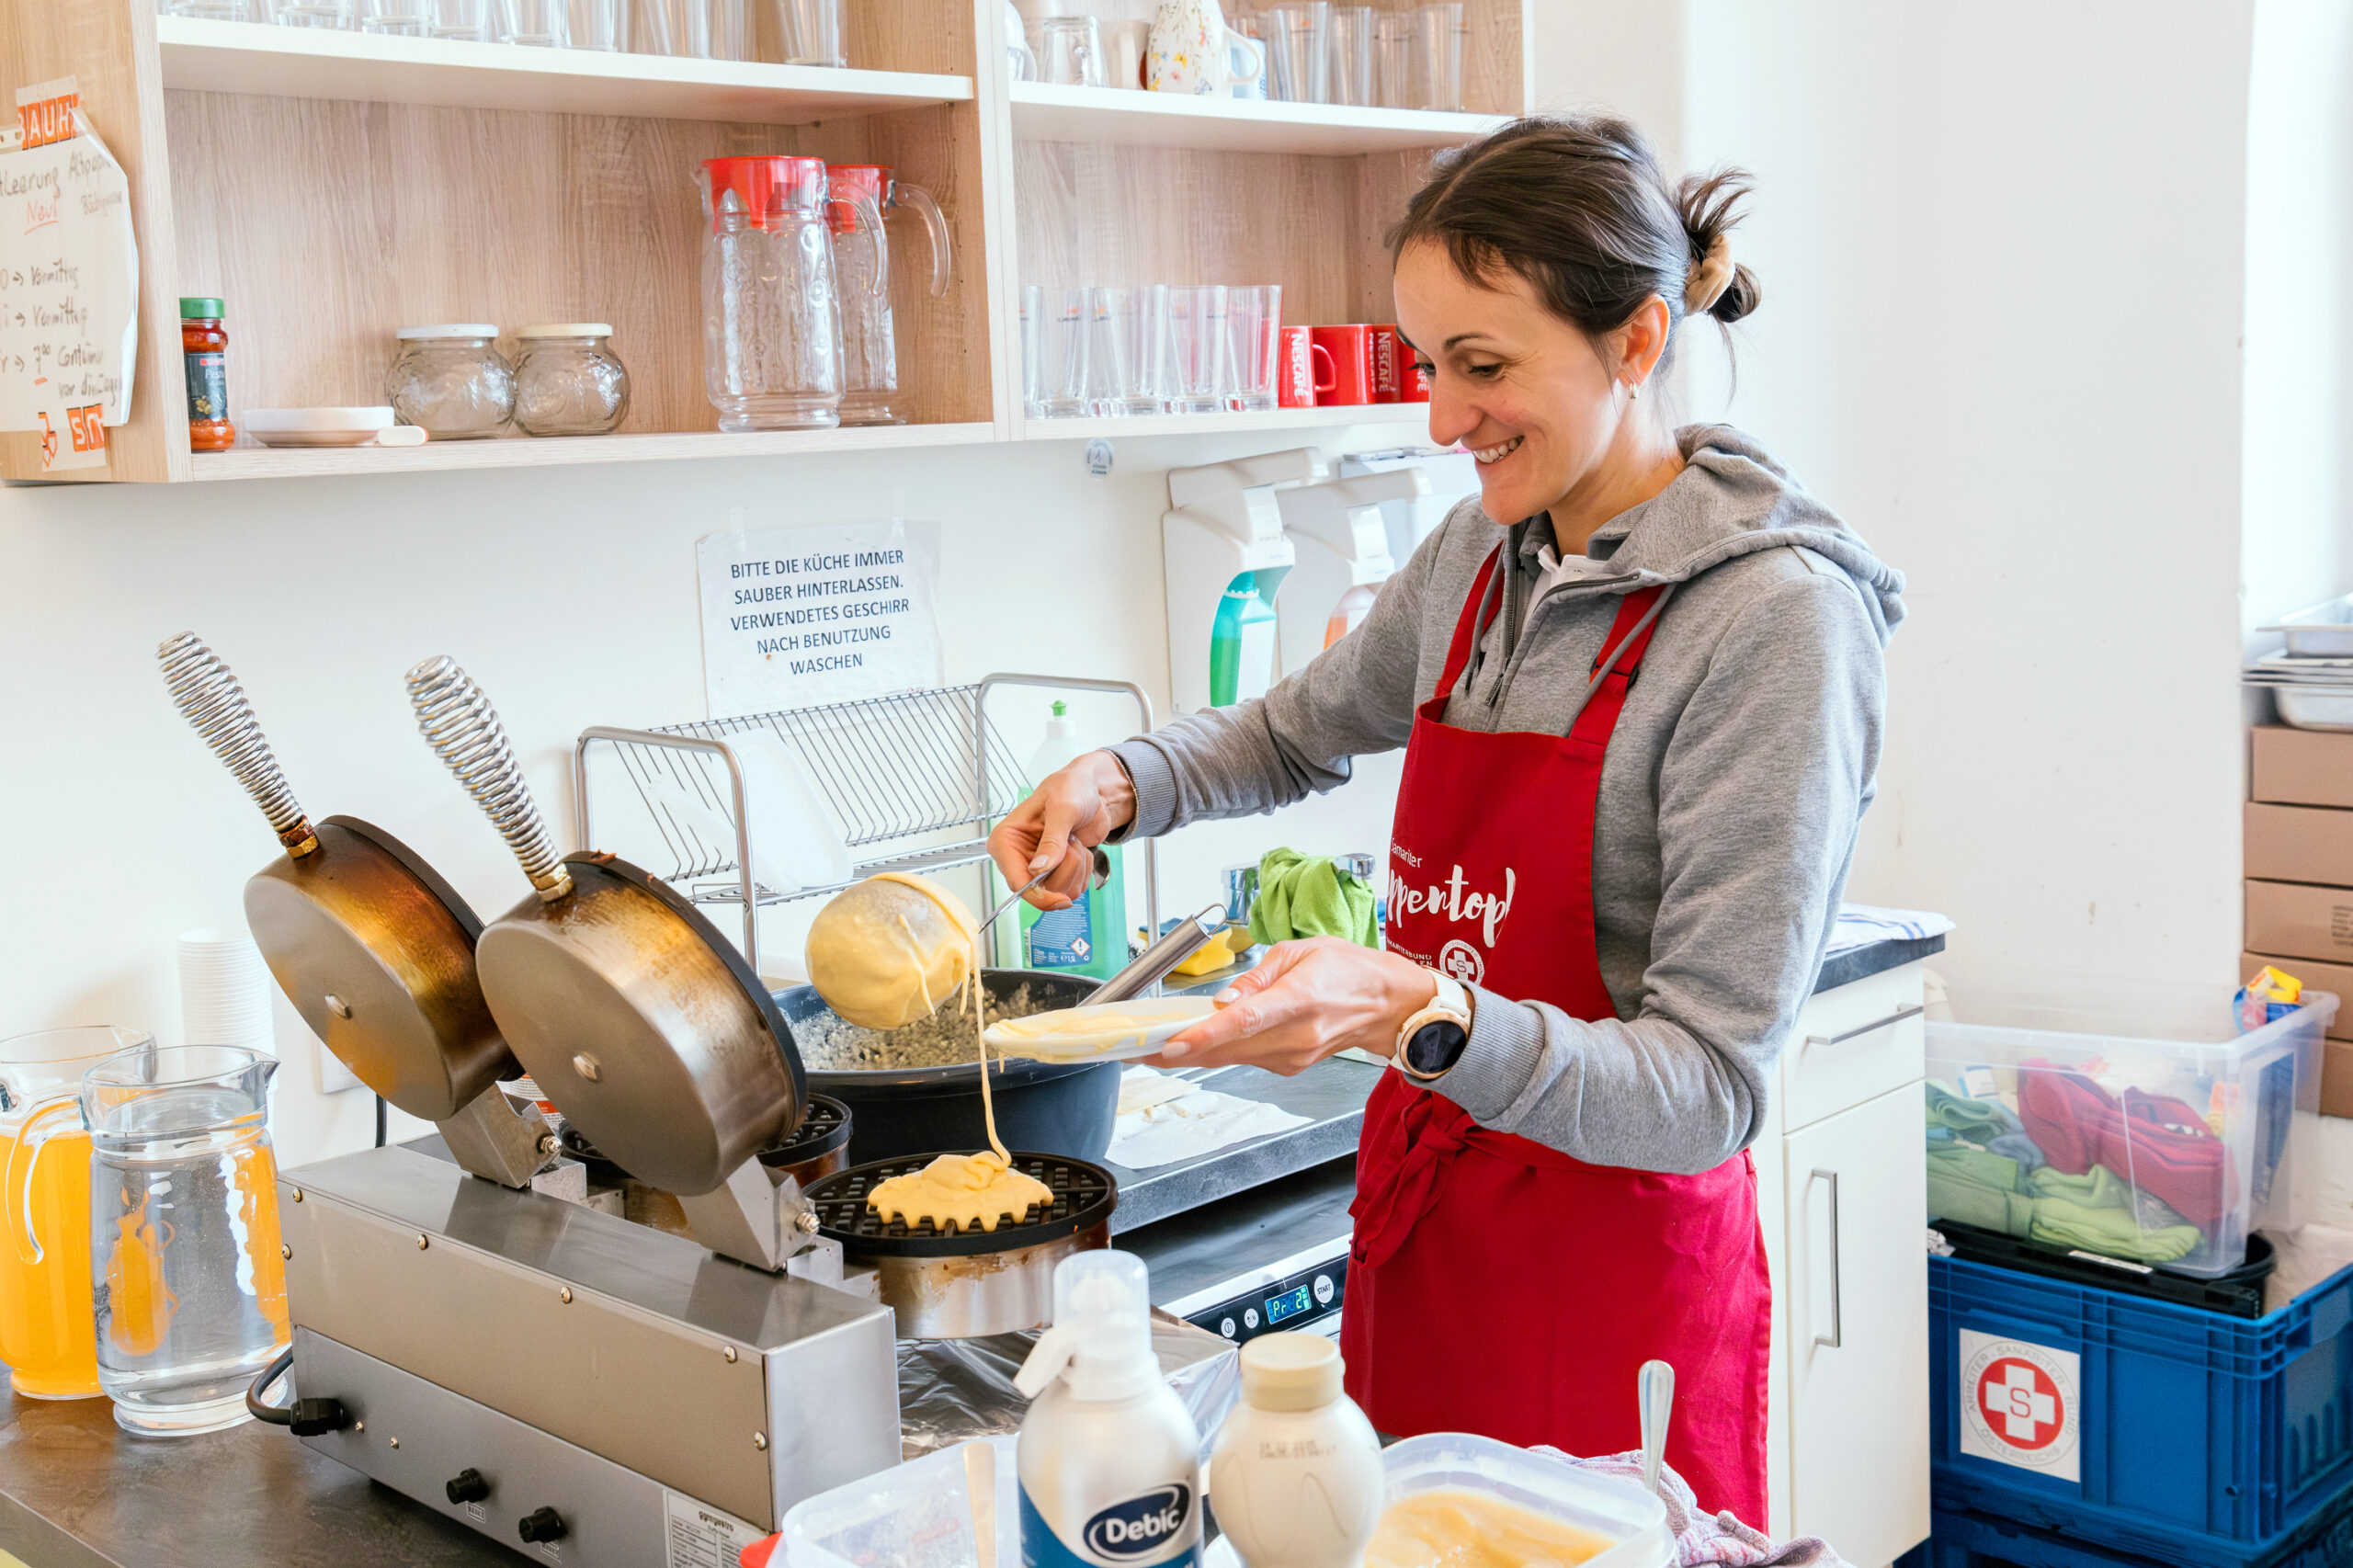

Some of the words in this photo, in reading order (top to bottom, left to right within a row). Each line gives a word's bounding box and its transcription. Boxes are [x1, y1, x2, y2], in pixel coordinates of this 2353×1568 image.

[1290, 333, 1309, 397] NESCAFÉ
[1378, 332, 1396, 392] NESCAFÉ
[731, 562, 770, 579] BITTE
[775, 559, 799, 574] DIE
[803, 552, 850, 572] KÜCHE
[854, 550, 904, 567] IMMER
[733, 585, 793, 605] SAUBER
[797, 574, 904, 598] HINTERLASSEN.
[730, 605, 839, 631] VERWENDETES
[842, 598, 909, 619] GESCHIRR
[756, 635, 800, 653] NACH
[803, 625, 892, 649] BENUTZUNG
[790, 653, 863, 675] WASCHEN
[1316, 1283, 1332, 1295] START
[2009, 1387, 2031, 1418] S
[1105, 1508, 1181, 1544] Debic
